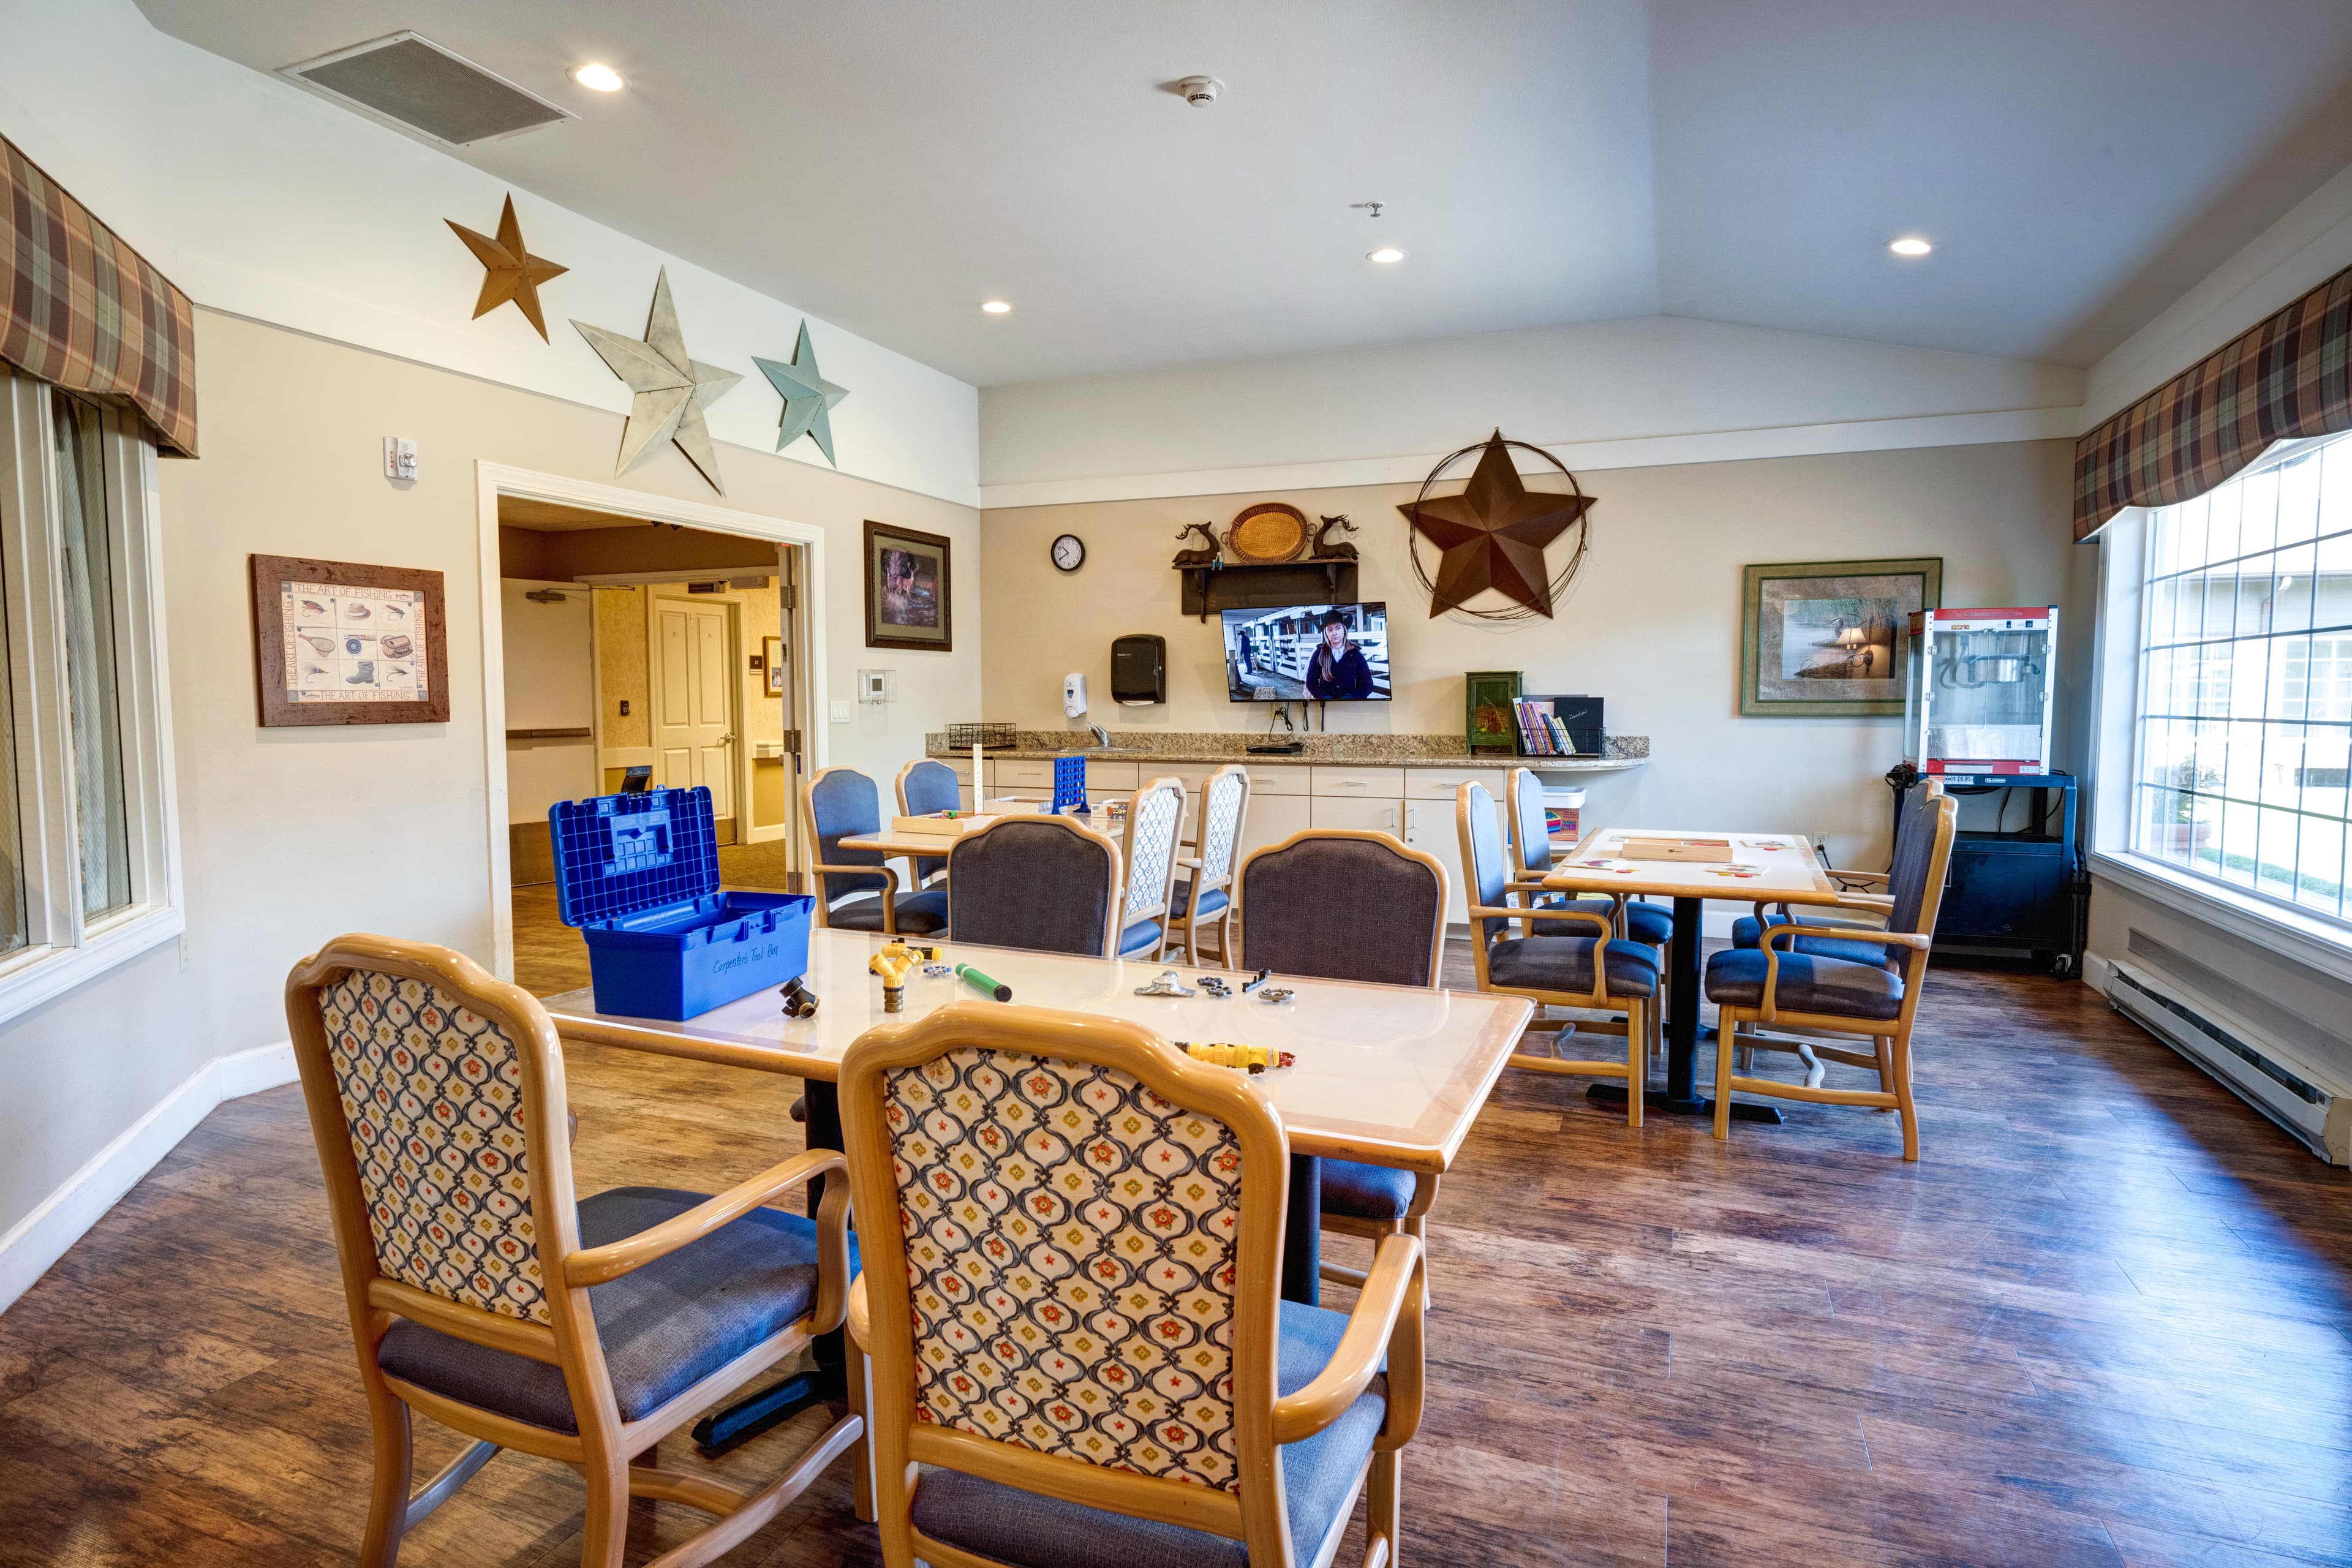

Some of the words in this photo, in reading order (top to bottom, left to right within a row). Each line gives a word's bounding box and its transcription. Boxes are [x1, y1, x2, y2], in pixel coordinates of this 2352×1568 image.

[295, 583, 316, 594] THE
[317, 585, 337, 596] ART
[340, 587, 351, 597] OF
[355, 588, 392, 600] FISHING
[284, 601, 295, 637] FISHING
[415, 609, 424, 640] FISHING
[285, 638, 295, 649] OF
[417, 642, 425, 652] OF
[286, 651, 296, 669] ART
[417, 655, 426, 669] ART
[287, 669, 298, 687] THE
[417, 669, 426, 682] THE
[319, 691, 336, 701] THE
[339, 691, 356, 701] ART
[358, 691, 369, 701] OF
[372, 691, 410, 701] FISHING
[713, 951, 748, 974] Carpenter's
[751, 946, 764, 962] Tool
[767, 943, 778, 957] Box
